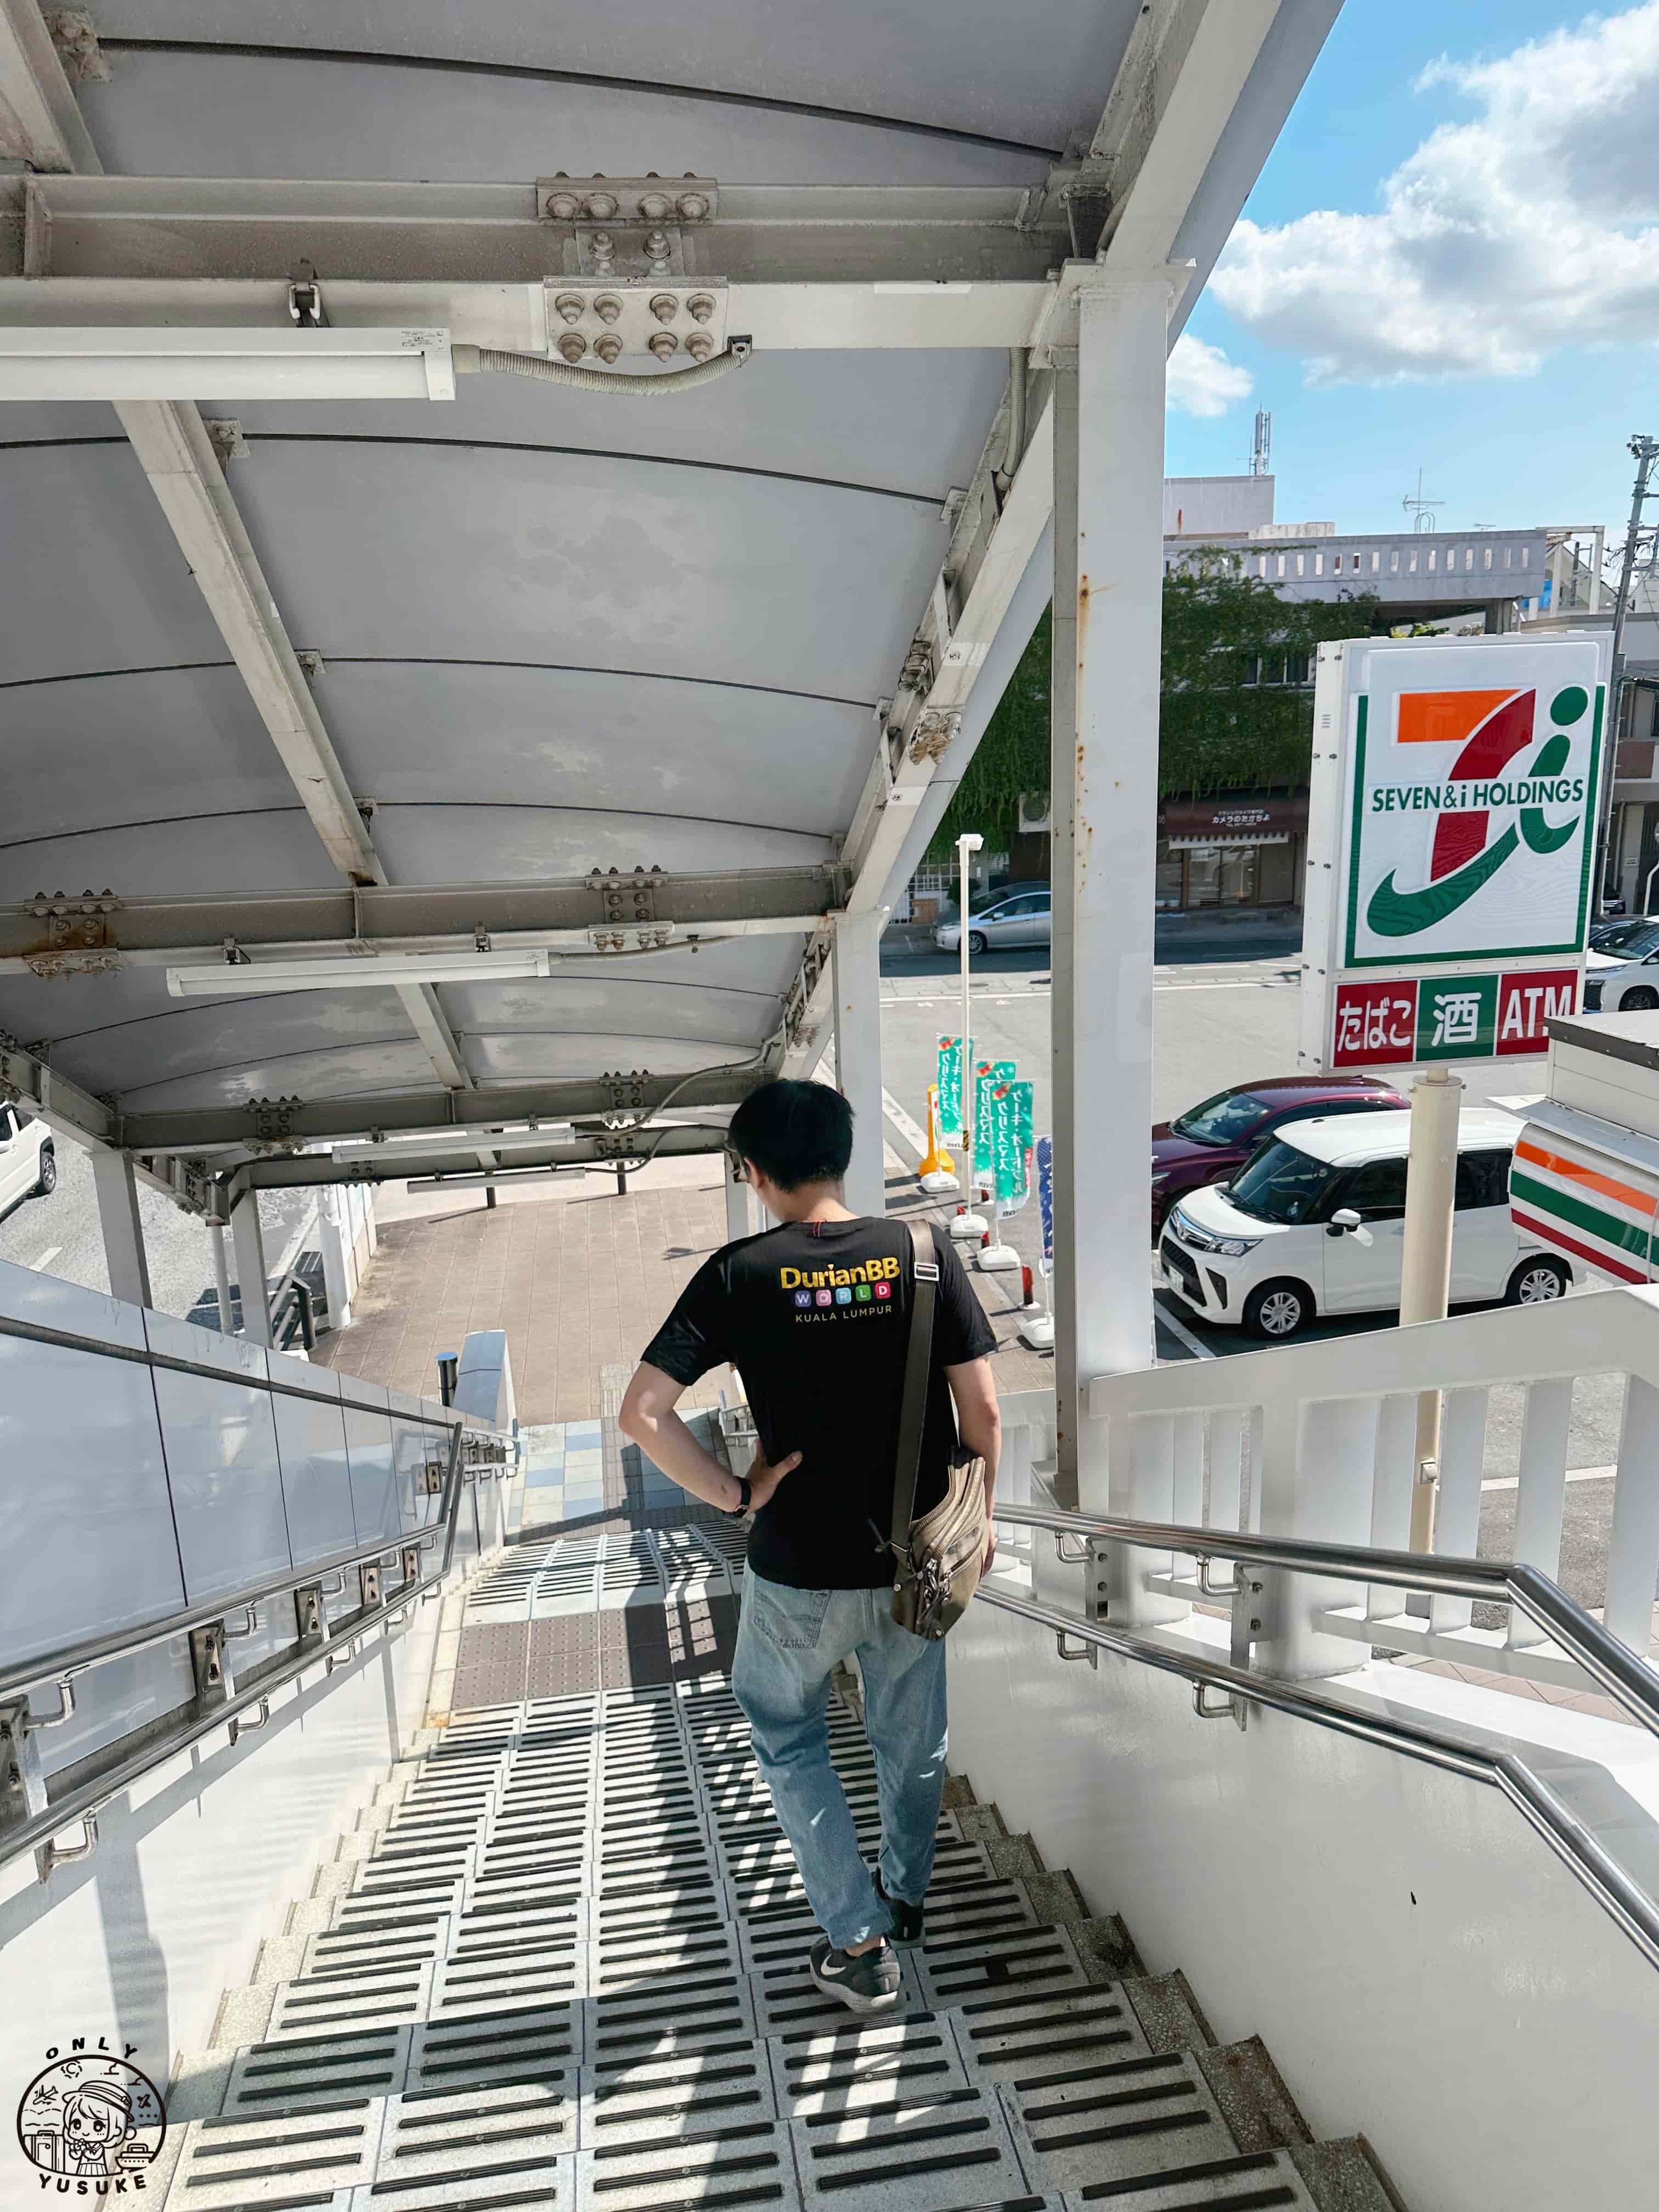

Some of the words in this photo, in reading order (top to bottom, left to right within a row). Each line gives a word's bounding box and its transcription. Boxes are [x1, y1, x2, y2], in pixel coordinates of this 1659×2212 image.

[1474, 779, 1583, 806] HOLDINGS
[1338, 997, 1412, 1052] たばこ
[1431, 992, 1482, 1047] 酒
[1501, 985, 1572, 1040] ATM
[780, 1257, 900, 1289] DurianBB
[796, 1284, 889, 1305] WORLD
[795, 1312, 837, 1323] KUALA
[843, 1305, 892, 1319] LUMPUR
